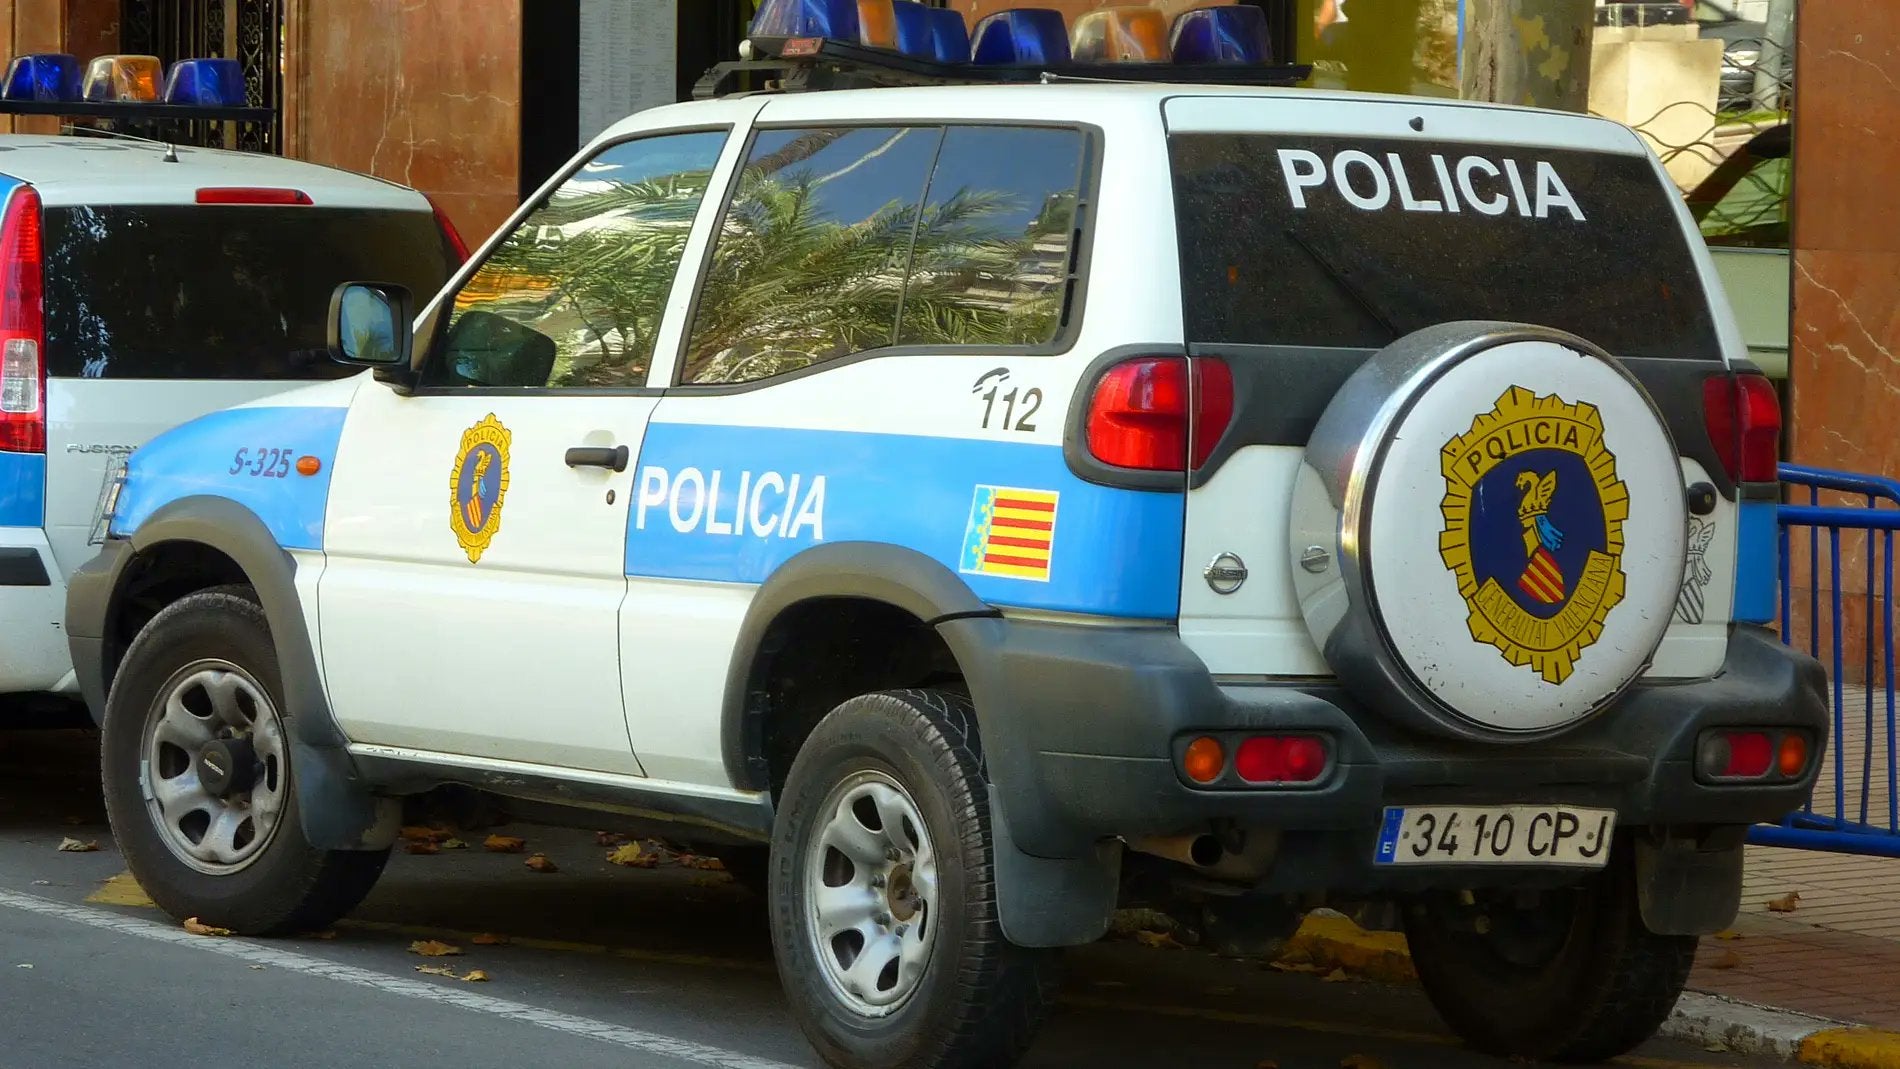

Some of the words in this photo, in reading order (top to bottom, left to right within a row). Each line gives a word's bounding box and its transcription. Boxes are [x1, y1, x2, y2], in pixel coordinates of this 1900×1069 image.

[1276, 148, 1588, 222] POLICIA
[981, 385, 1043, 433] 112
[228, 446, 294, 478] S-325
[466, 431, 504, 450] POLICIA
[1466, 421, 1579, 475] POLICIA
[635, 465, 827, 541] POLICIA
[1382, 841, 1393, 854] E
[1411, 811, 1516, 858] 3410
[1526, 811, 1610, 858] CPJ
